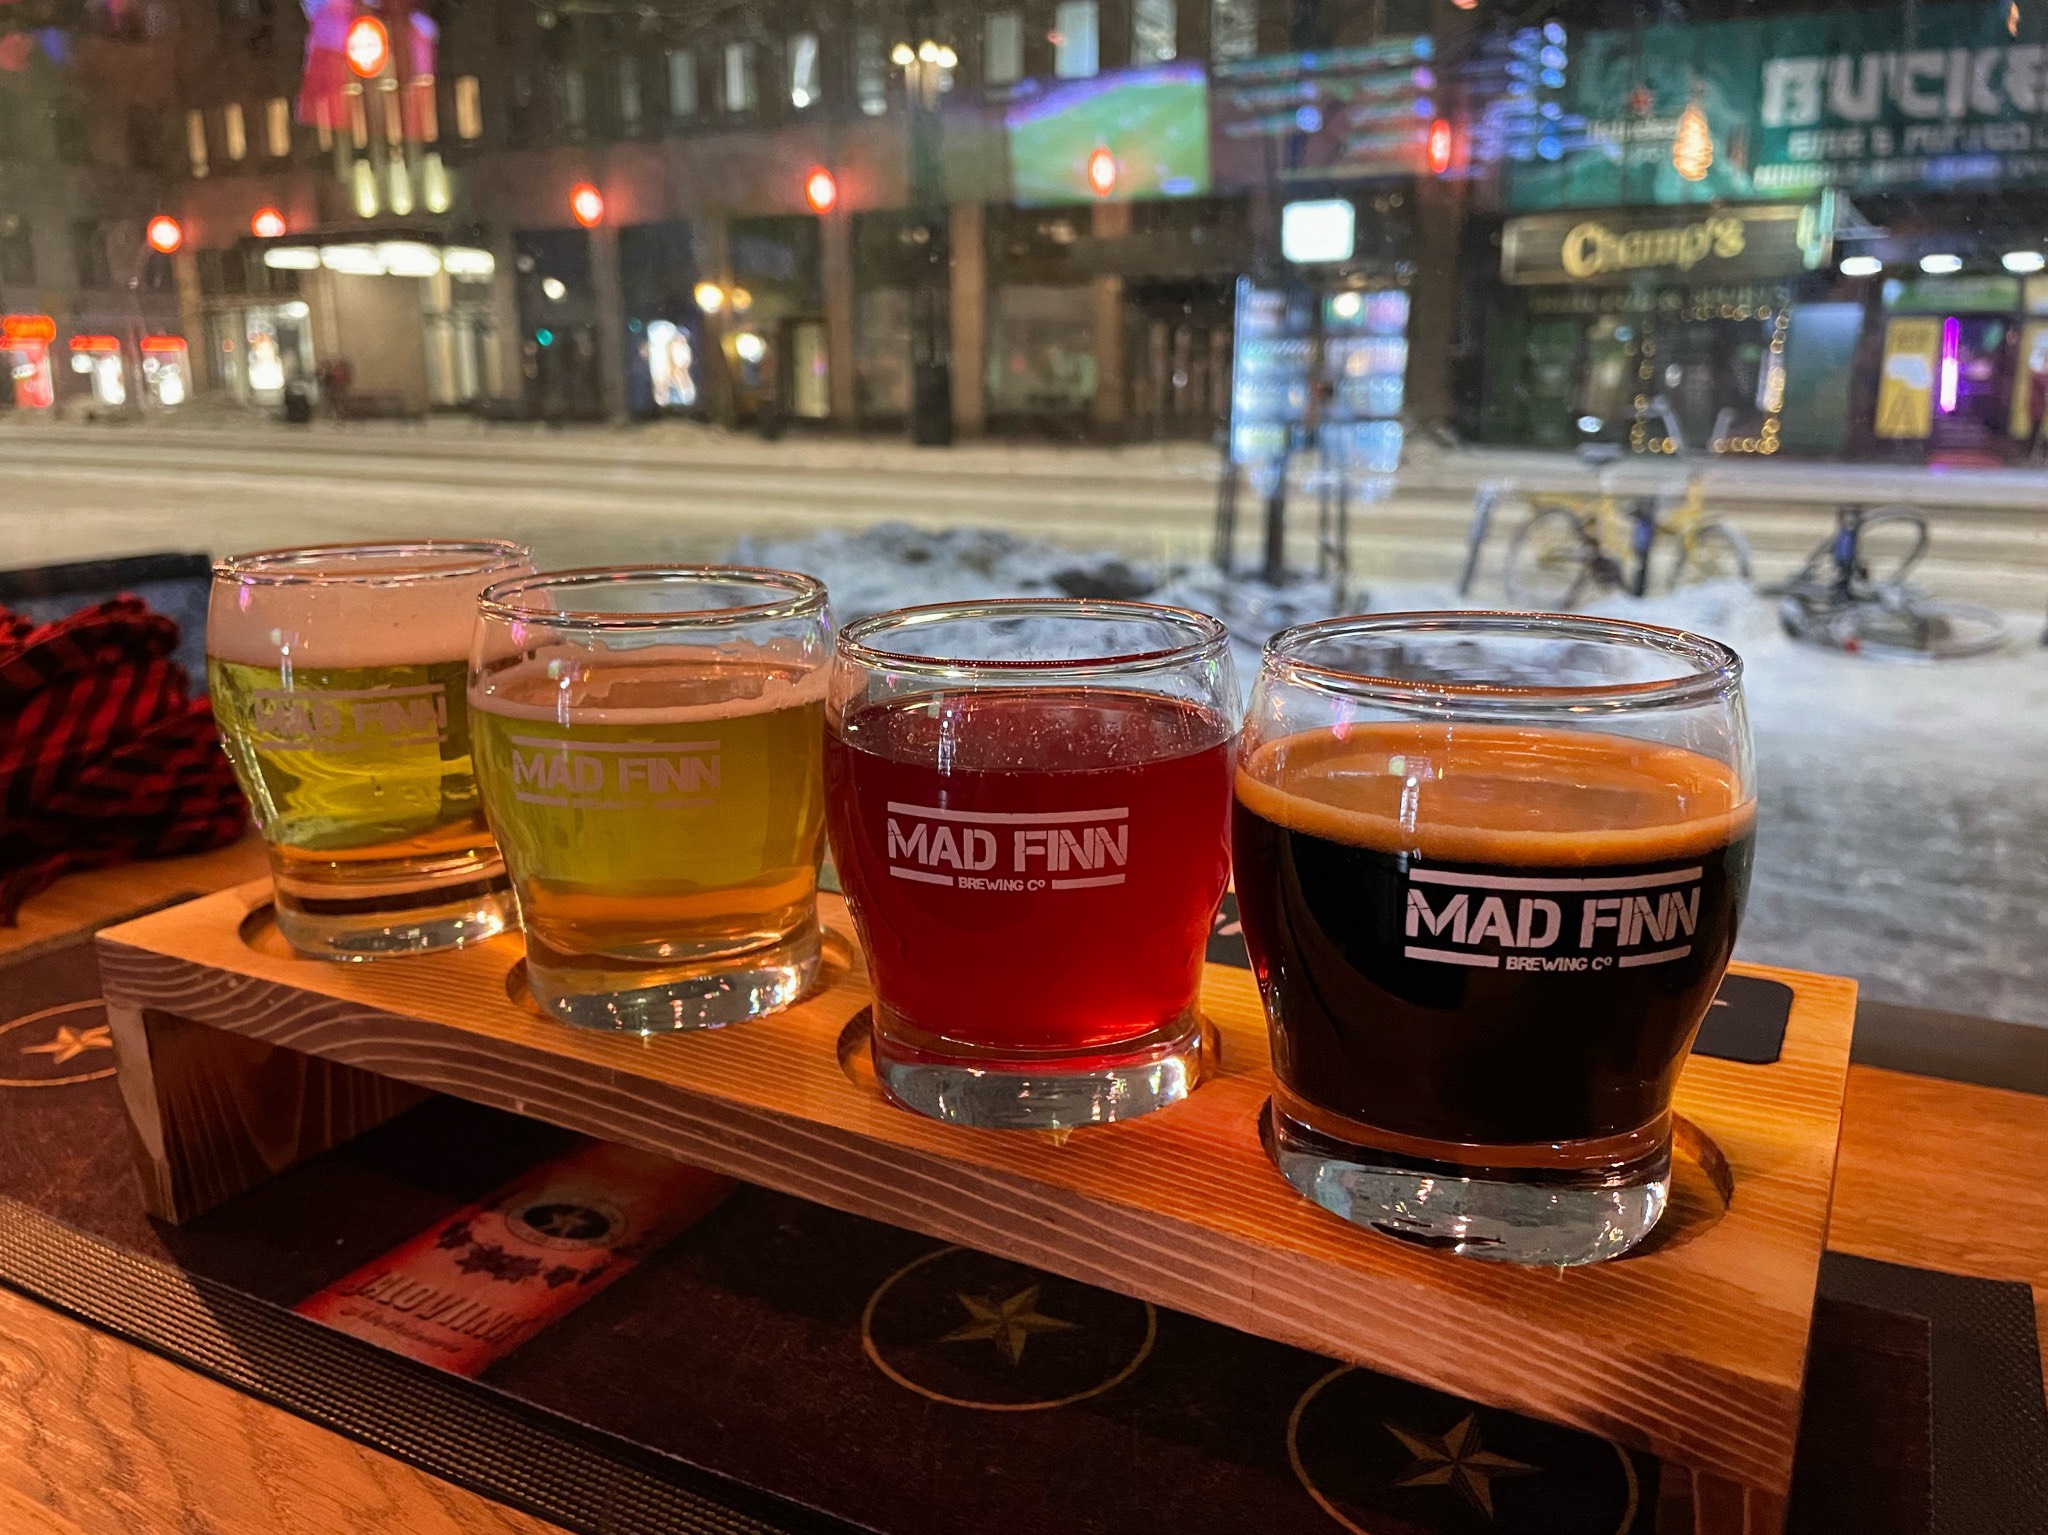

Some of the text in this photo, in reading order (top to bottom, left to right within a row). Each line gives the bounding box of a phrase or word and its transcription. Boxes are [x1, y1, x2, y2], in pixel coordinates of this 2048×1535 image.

[511, 749, 722, 794] MAD FINN
[887, 817, 1129, 873] MAD FINN
[957, 876, 1025, 892] BREWING
[1404, 886, 1701, 949] MAD FINN
[1505, 956, 1588, 972] BREWING
